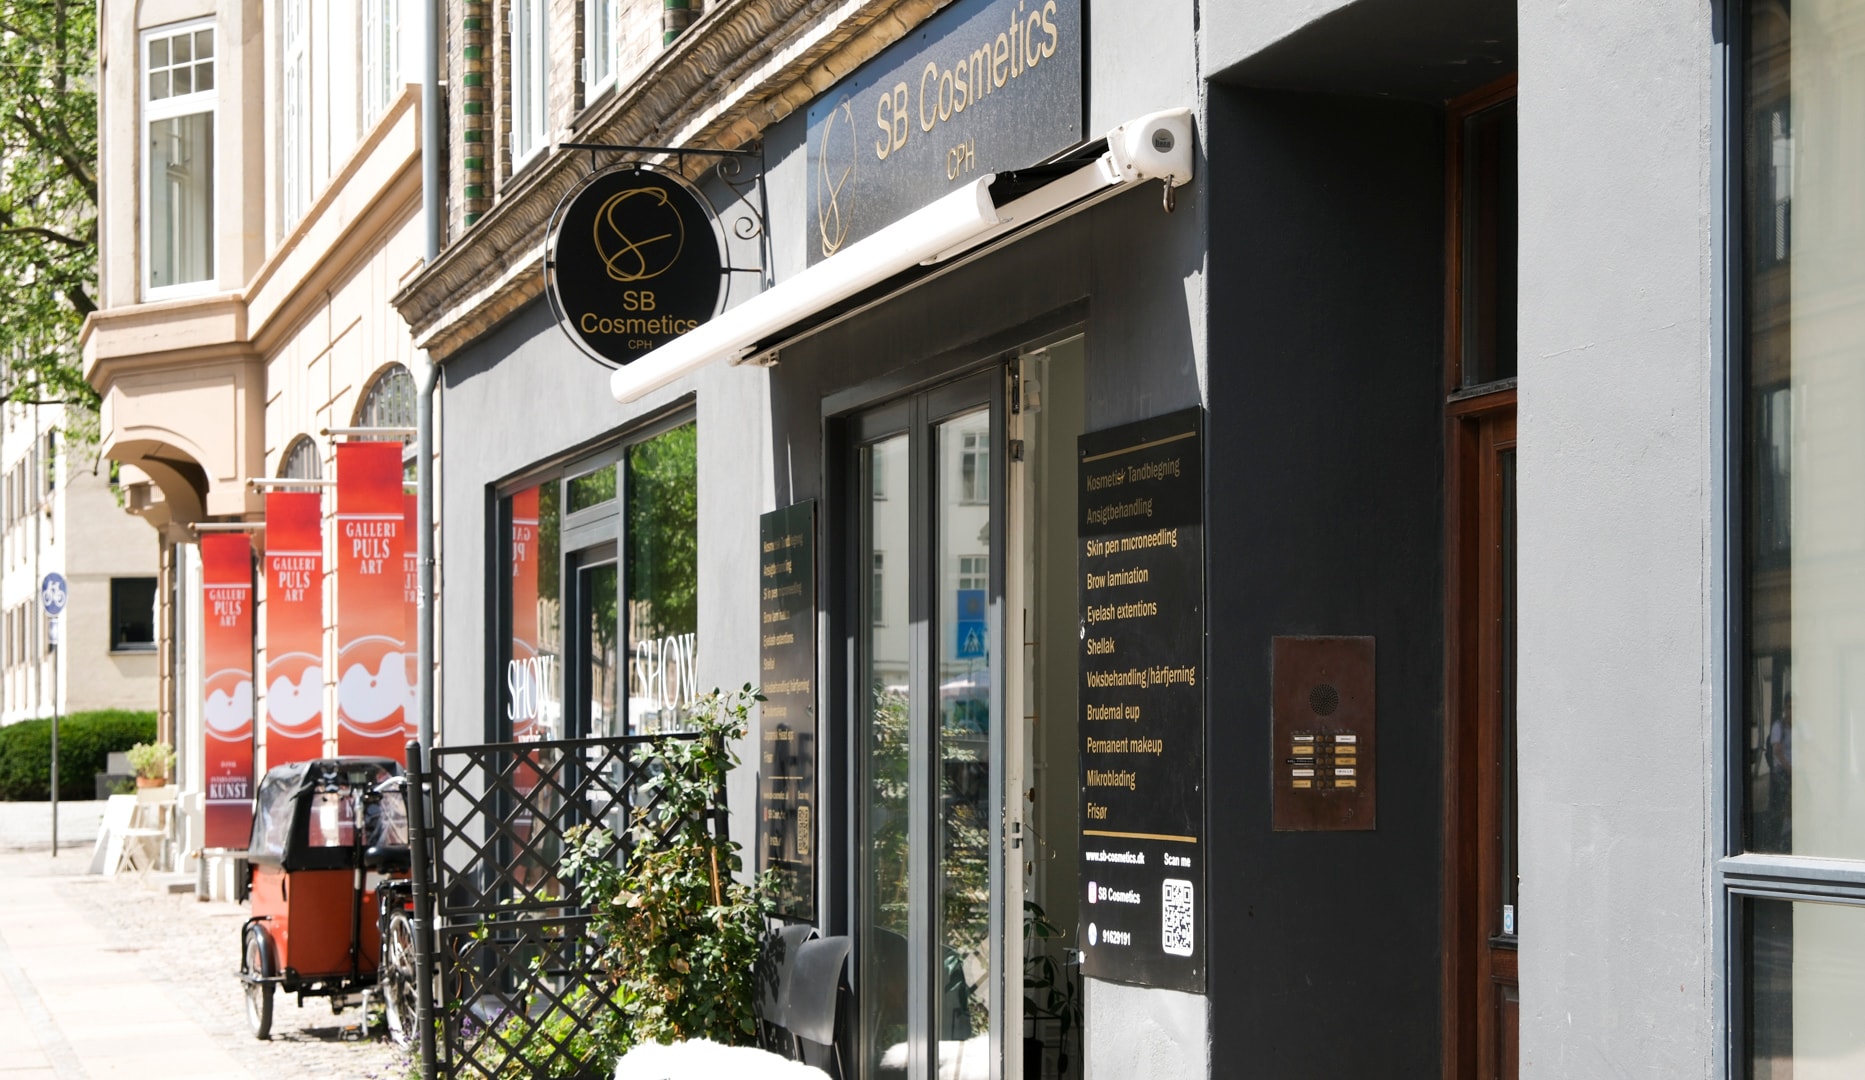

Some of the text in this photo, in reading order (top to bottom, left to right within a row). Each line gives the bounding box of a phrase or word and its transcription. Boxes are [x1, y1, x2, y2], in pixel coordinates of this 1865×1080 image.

[876, 0, 1058, 160] SB Cosmetics
[947, 137, 975, 180] CPH
[623, 290, 656, 311] SB
[580, 312, 698, 335] Cosmetics
[627, 339, 653, 350] CPH
[1127, 458, 1181, 483] Tandblegning
[1086, 498, 1153, 525] Ansigtbehandling
[346, 522, 396, 538] GALLERI
[353, 538, 390, 559] PULS
[1086, 528, 1178, 558] Skin pen microneedling
[273, 557, 315, 571] GALLERI
[360, 559, 383, 575] ART
[279, 571, 311, 588] PULS
[1087, 566, 1149, 590] Brow lamination
[209, 589, 246, 601] GALLERI
[284, 588, 305, 602] ART
[213, 600, 242, 616] PULS
[1087, 600, 1157, 626] Eyelash extentions
[220, 615, 236, 627] ART
[1087, 637, 1115, 655] Shellak
[636, 633, 699, 711] SHOW
[507, 654, 554, 721] SHOW
[1087, 736, 1163, 757] Permanent makeup
[1087, 770, 1136, 791] Mikroblading
[210, 783, 248, 799] KUNST
[1087, 802, 1108, 820] Frisør
[1085, 849, 1145, 865] www.sb-cosmetics.dk
[1164, 852, 1191, 867] Scan me
[1098, 886, 1141, 905] SB Cosmetics
